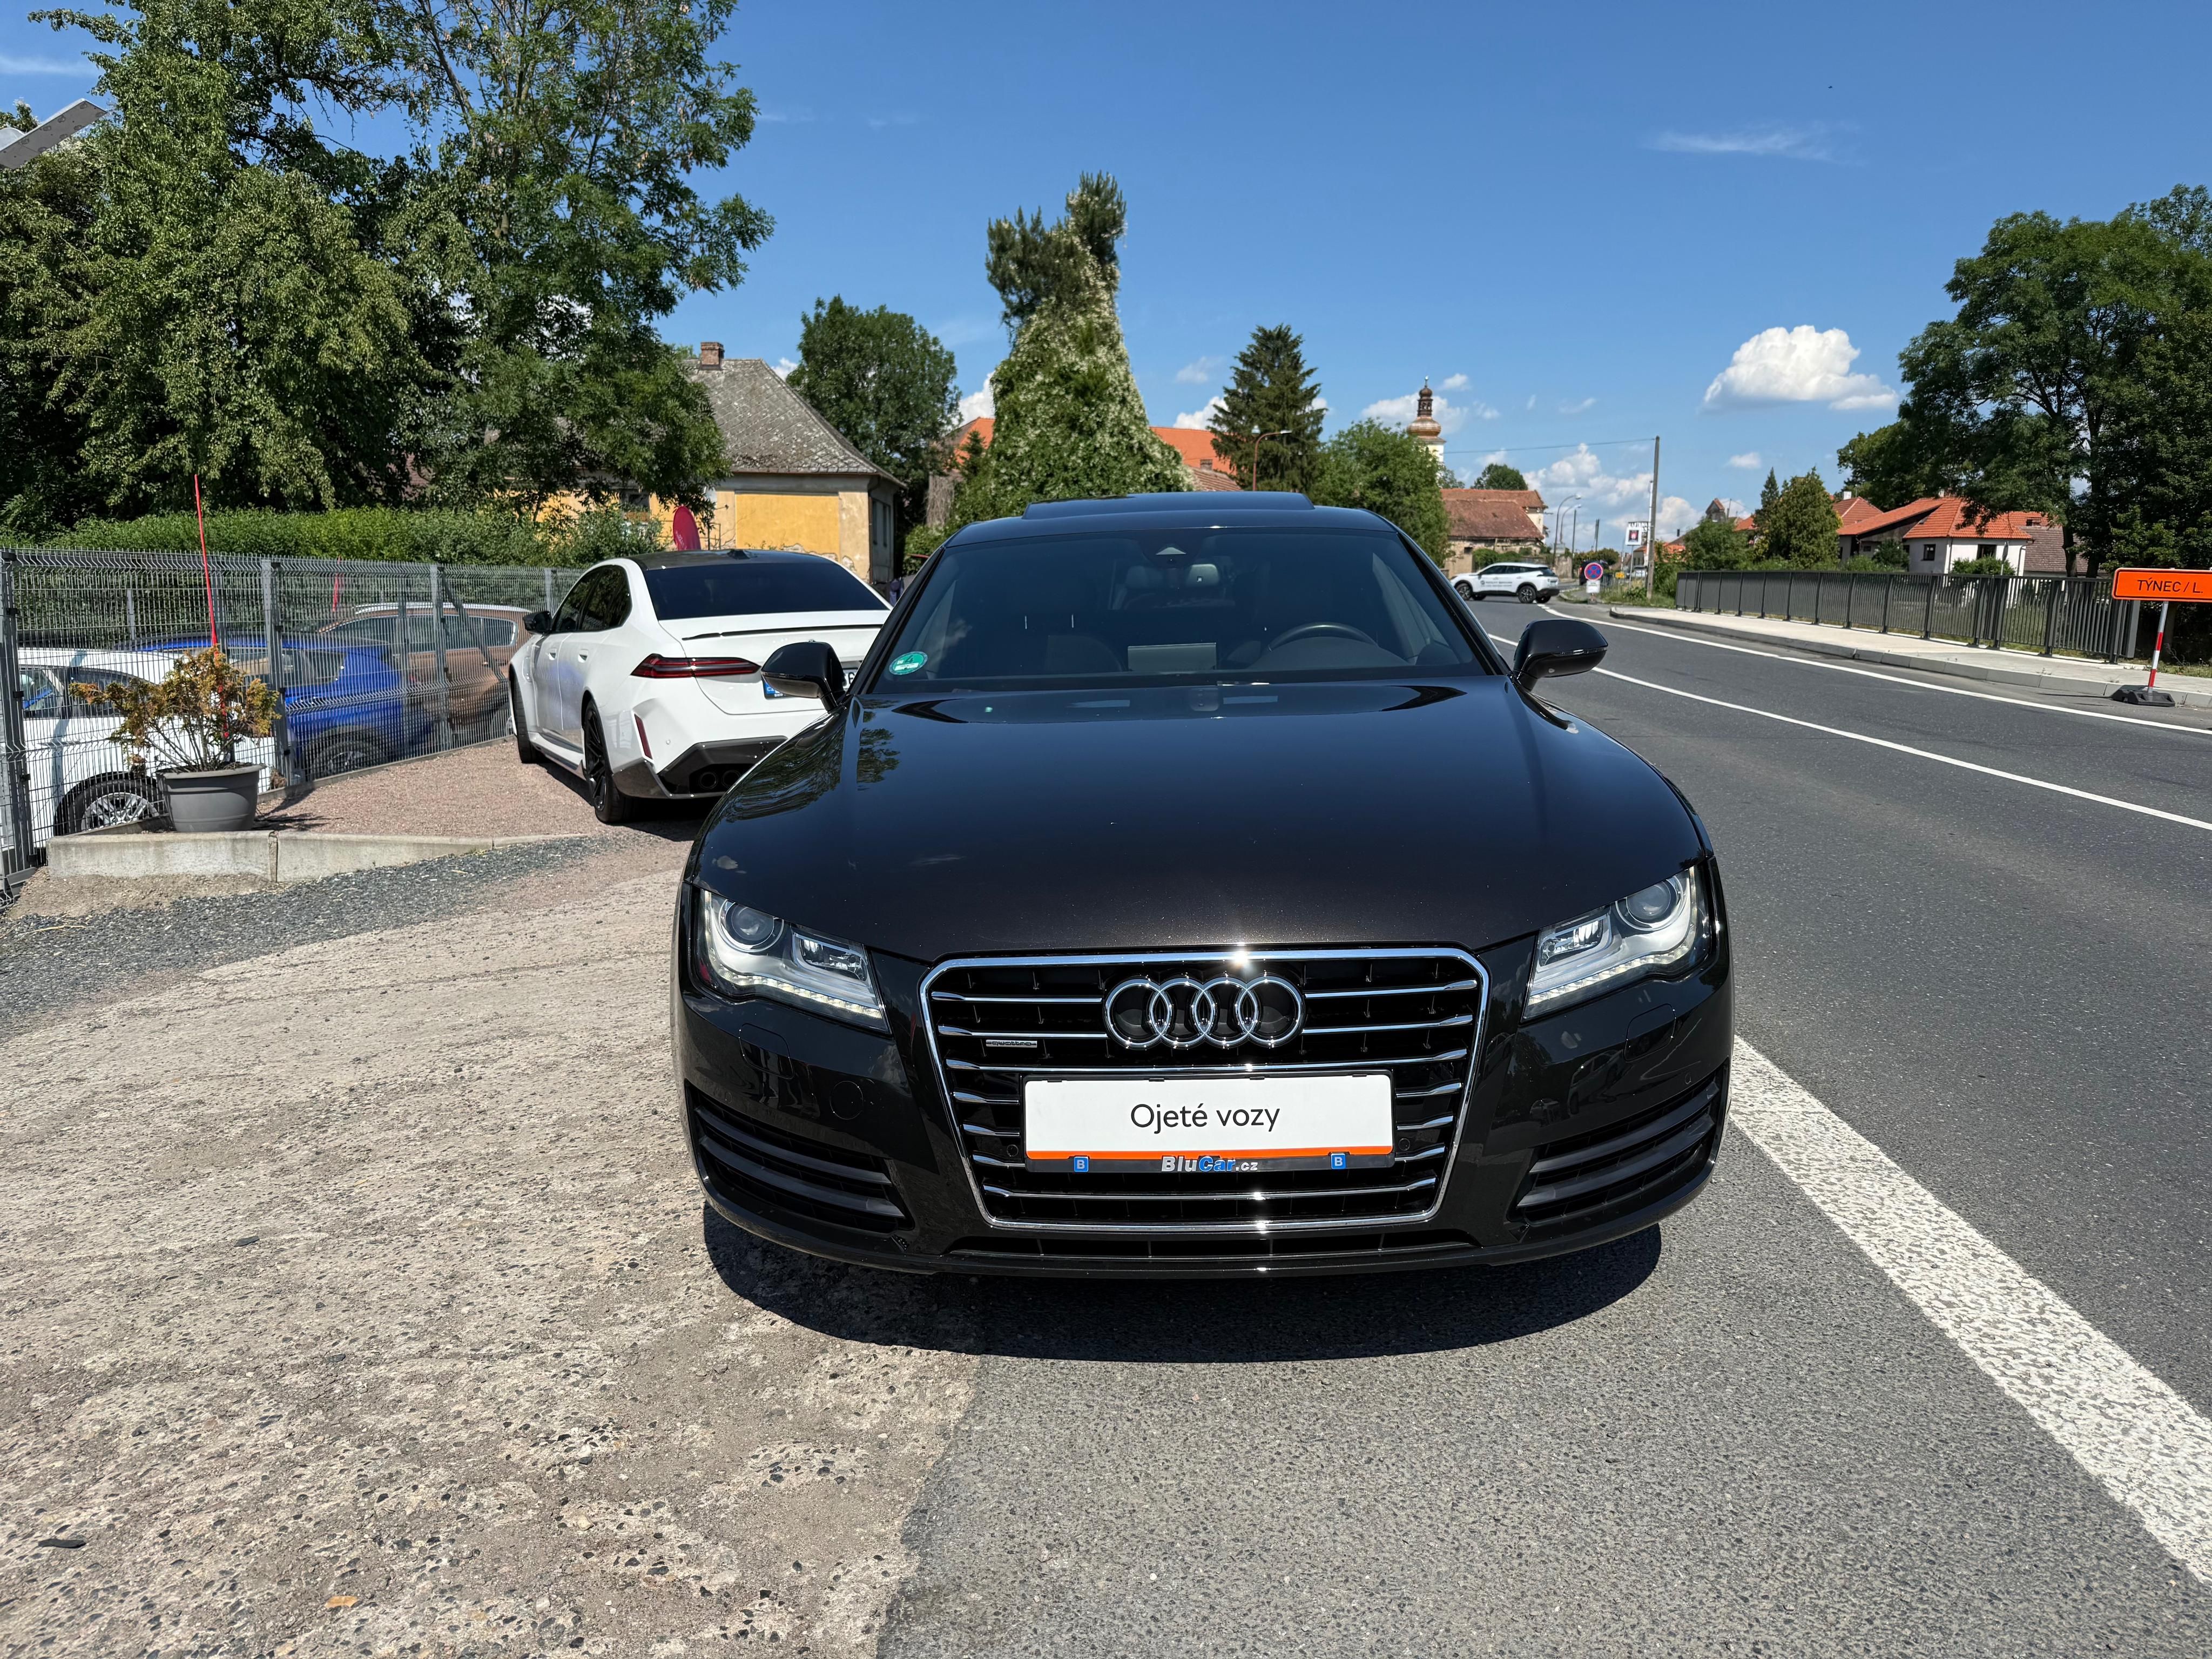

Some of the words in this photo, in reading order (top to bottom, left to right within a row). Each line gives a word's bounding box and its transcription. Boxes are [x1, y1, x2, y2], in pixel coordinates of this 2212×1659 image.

[1131, 1103, 1208, 1134] Ojeté
[1216, 1108, 1280, 1132] vozy
[1077, 1159, 1085, 1169] B
[1161, 1156, 1258, 1172] BluCar.cz
[1334, 1157, 1343, 1166] B
